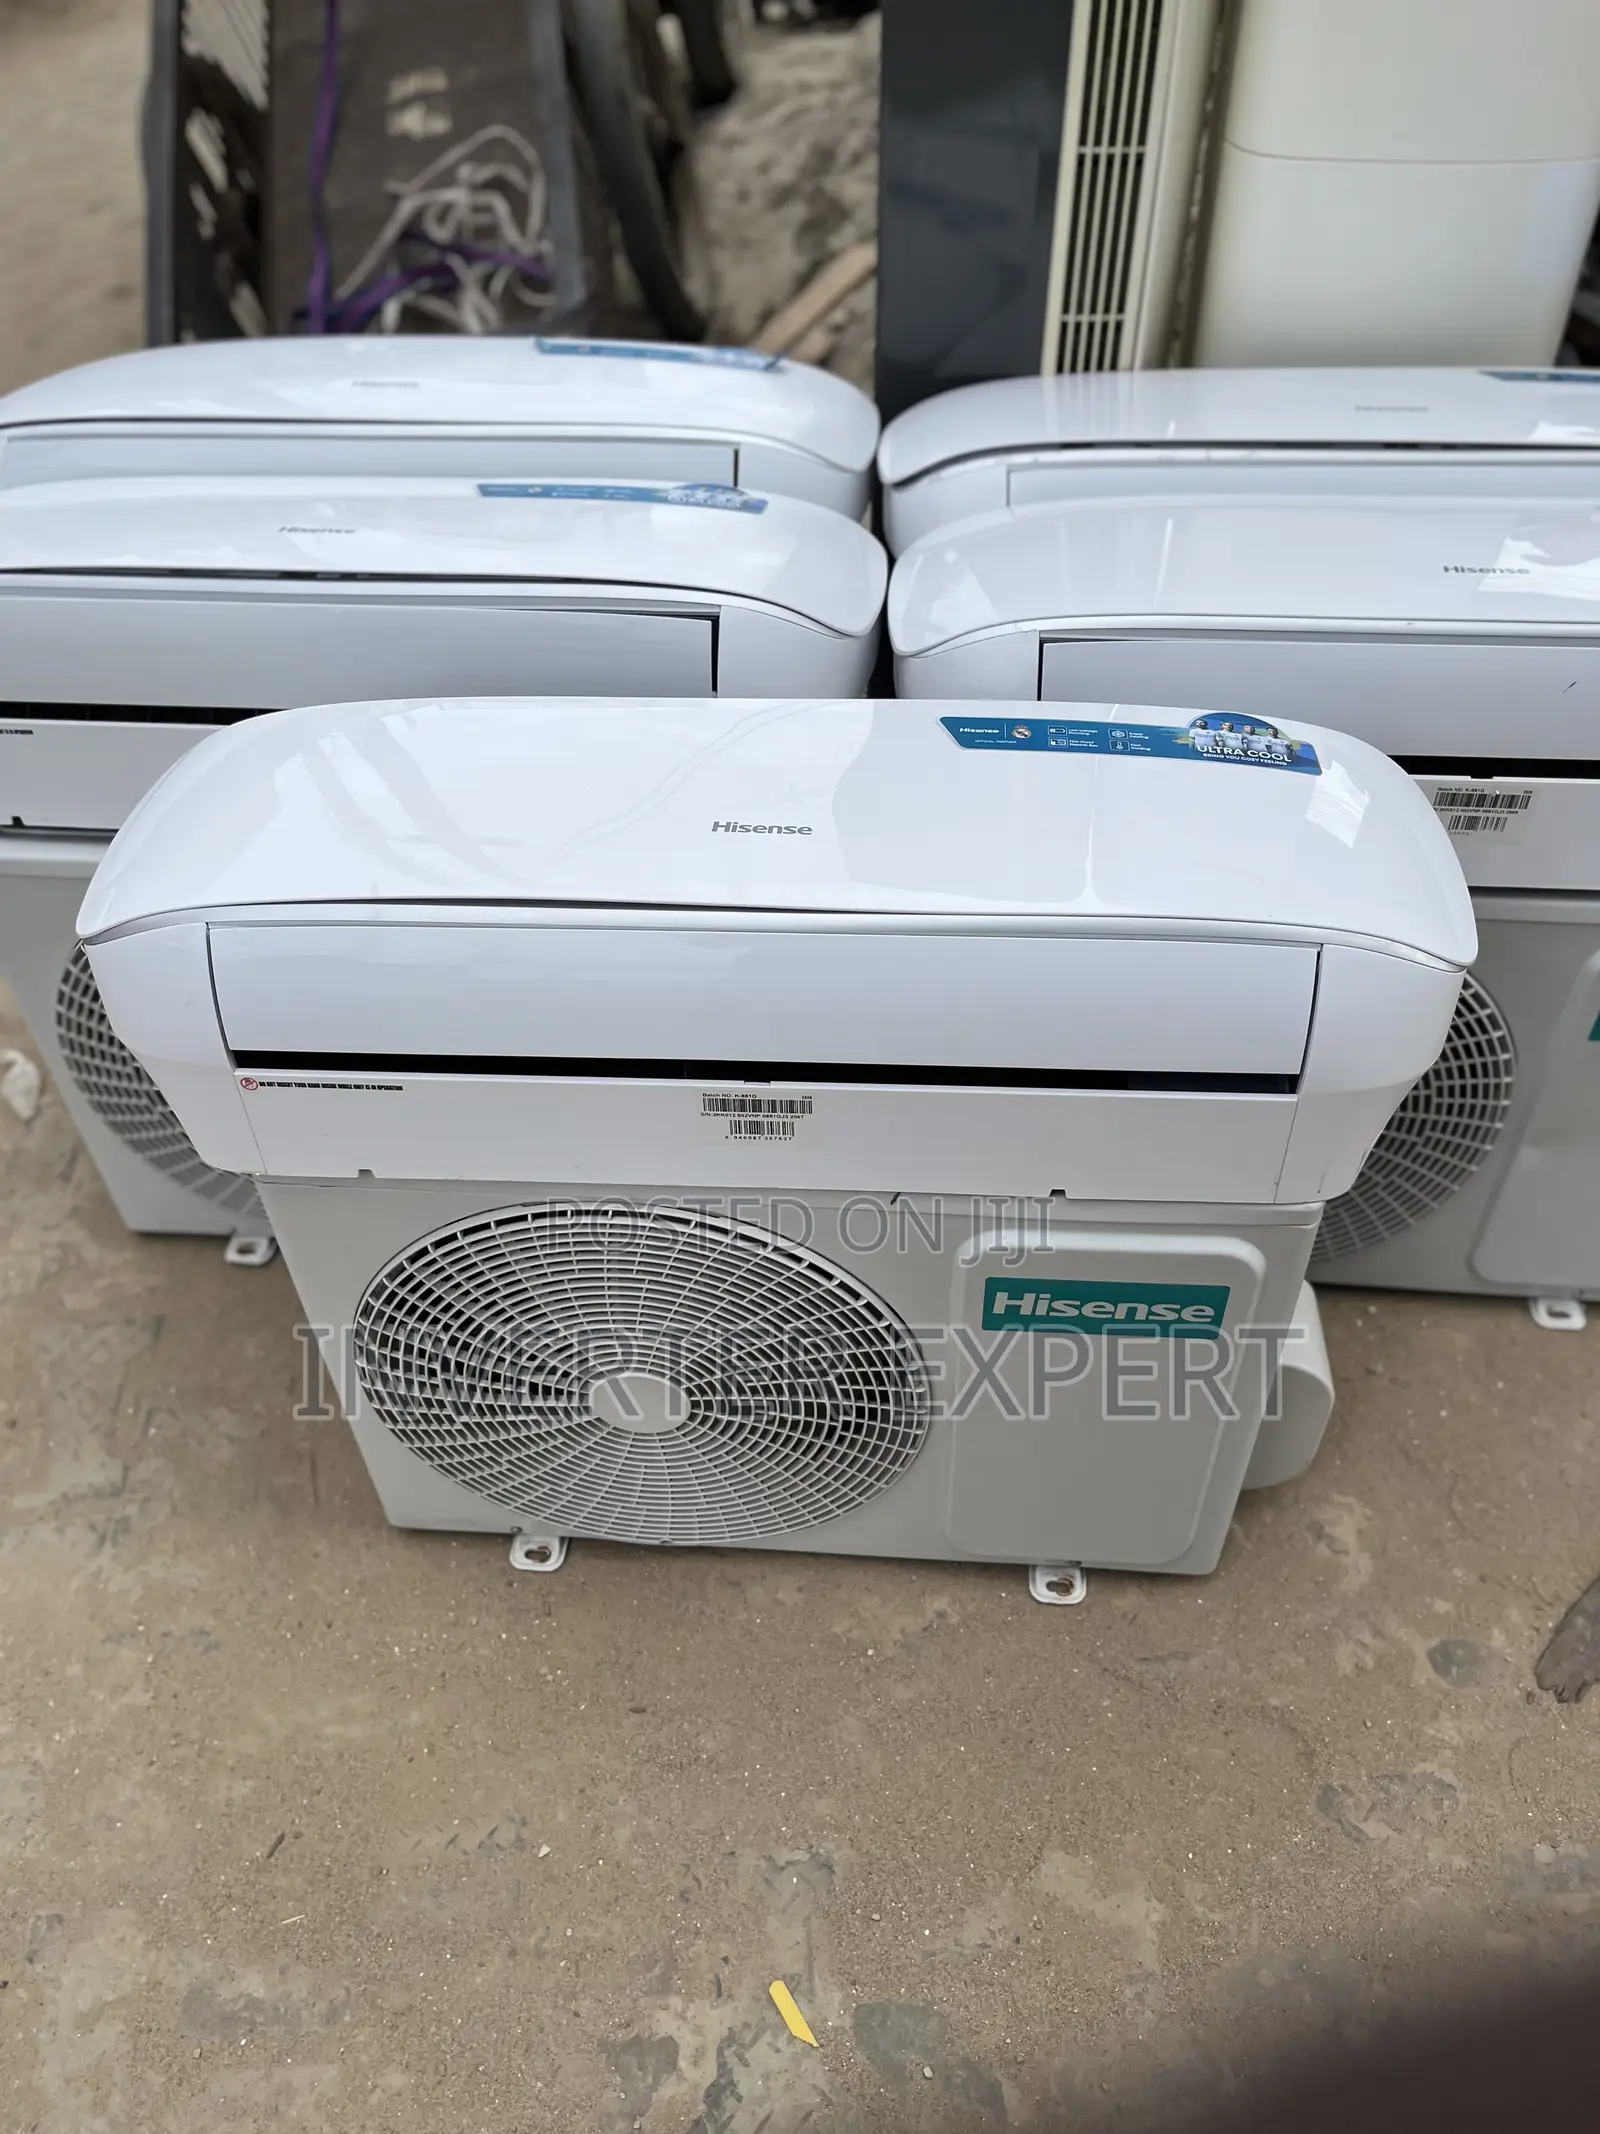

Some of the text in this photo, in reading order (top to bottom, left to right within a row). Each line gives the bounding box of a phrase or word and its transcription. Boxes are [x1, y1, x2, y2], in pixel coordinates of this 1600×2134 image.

[1443, 565, 1530, 575] Hisense
[1197, 745, 1292, 763] ULTRA COOL
[1260, 758, 1287, 766] FEELING
[711, 821, 813, 835] Hisense
[992, 1291, 1216, 1323] Hisense
